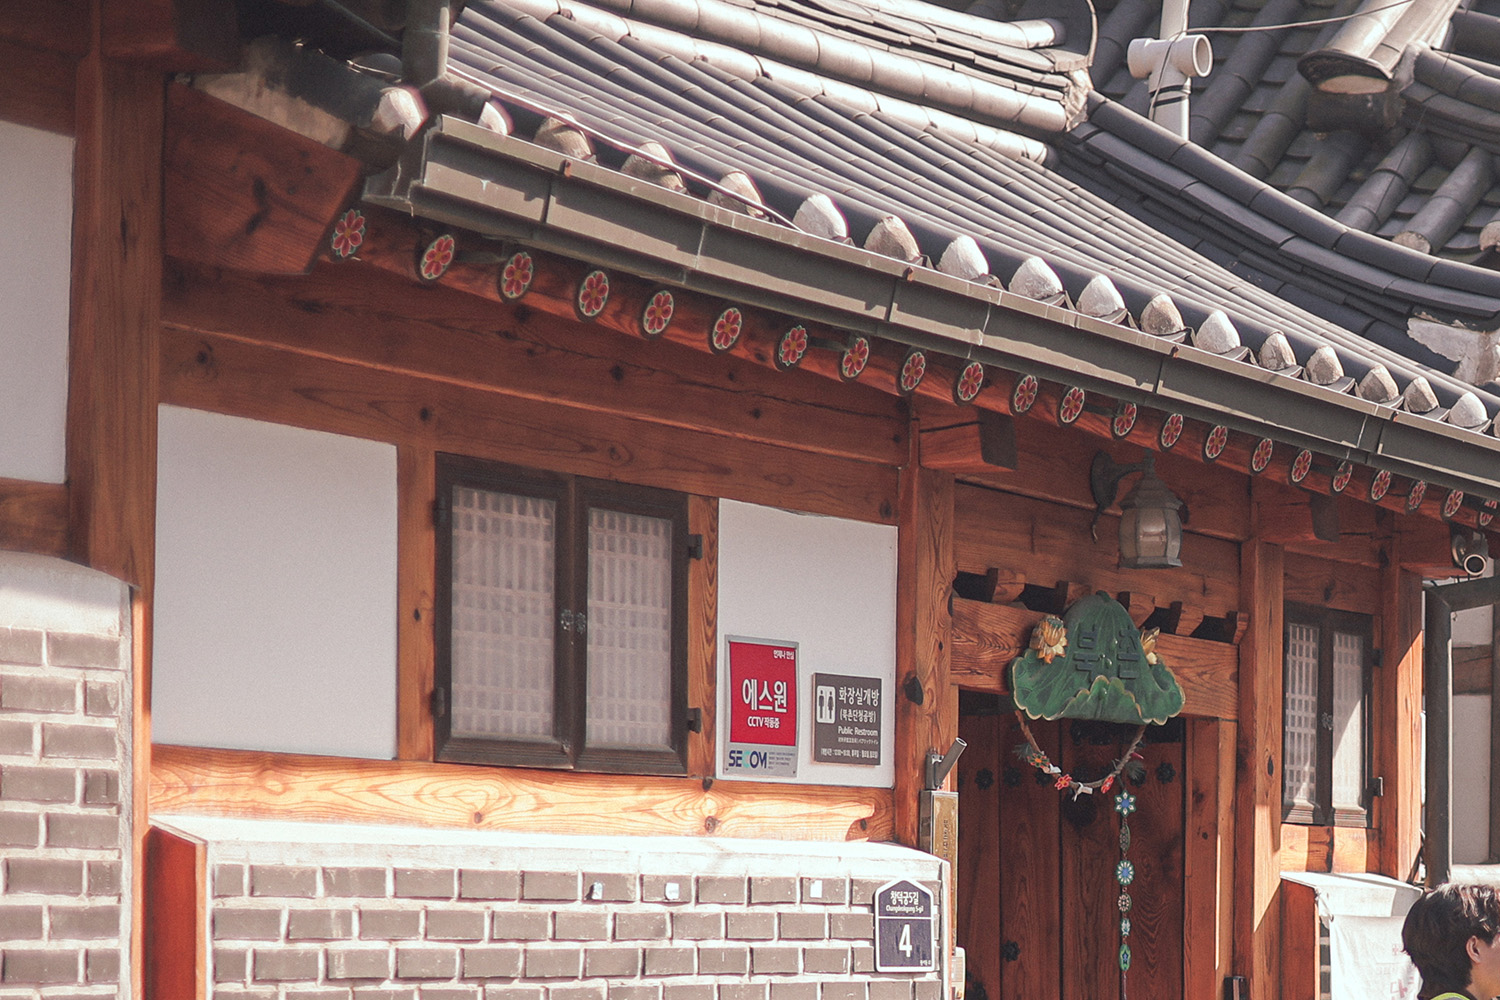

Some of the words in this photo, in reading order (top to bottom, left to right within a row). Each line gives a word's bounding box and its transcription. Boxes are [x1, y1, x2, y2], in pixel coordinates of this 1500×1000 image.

[742, 678, 788, 713] 에스원
[838, 725, 854, 736] Public
[854, 726, 879, 737] Restroom
[728, 750, 767, 769] SECOM
[890, 890, 919, 905] 창덕궁5길
[899, 923, 913, 958] 4
